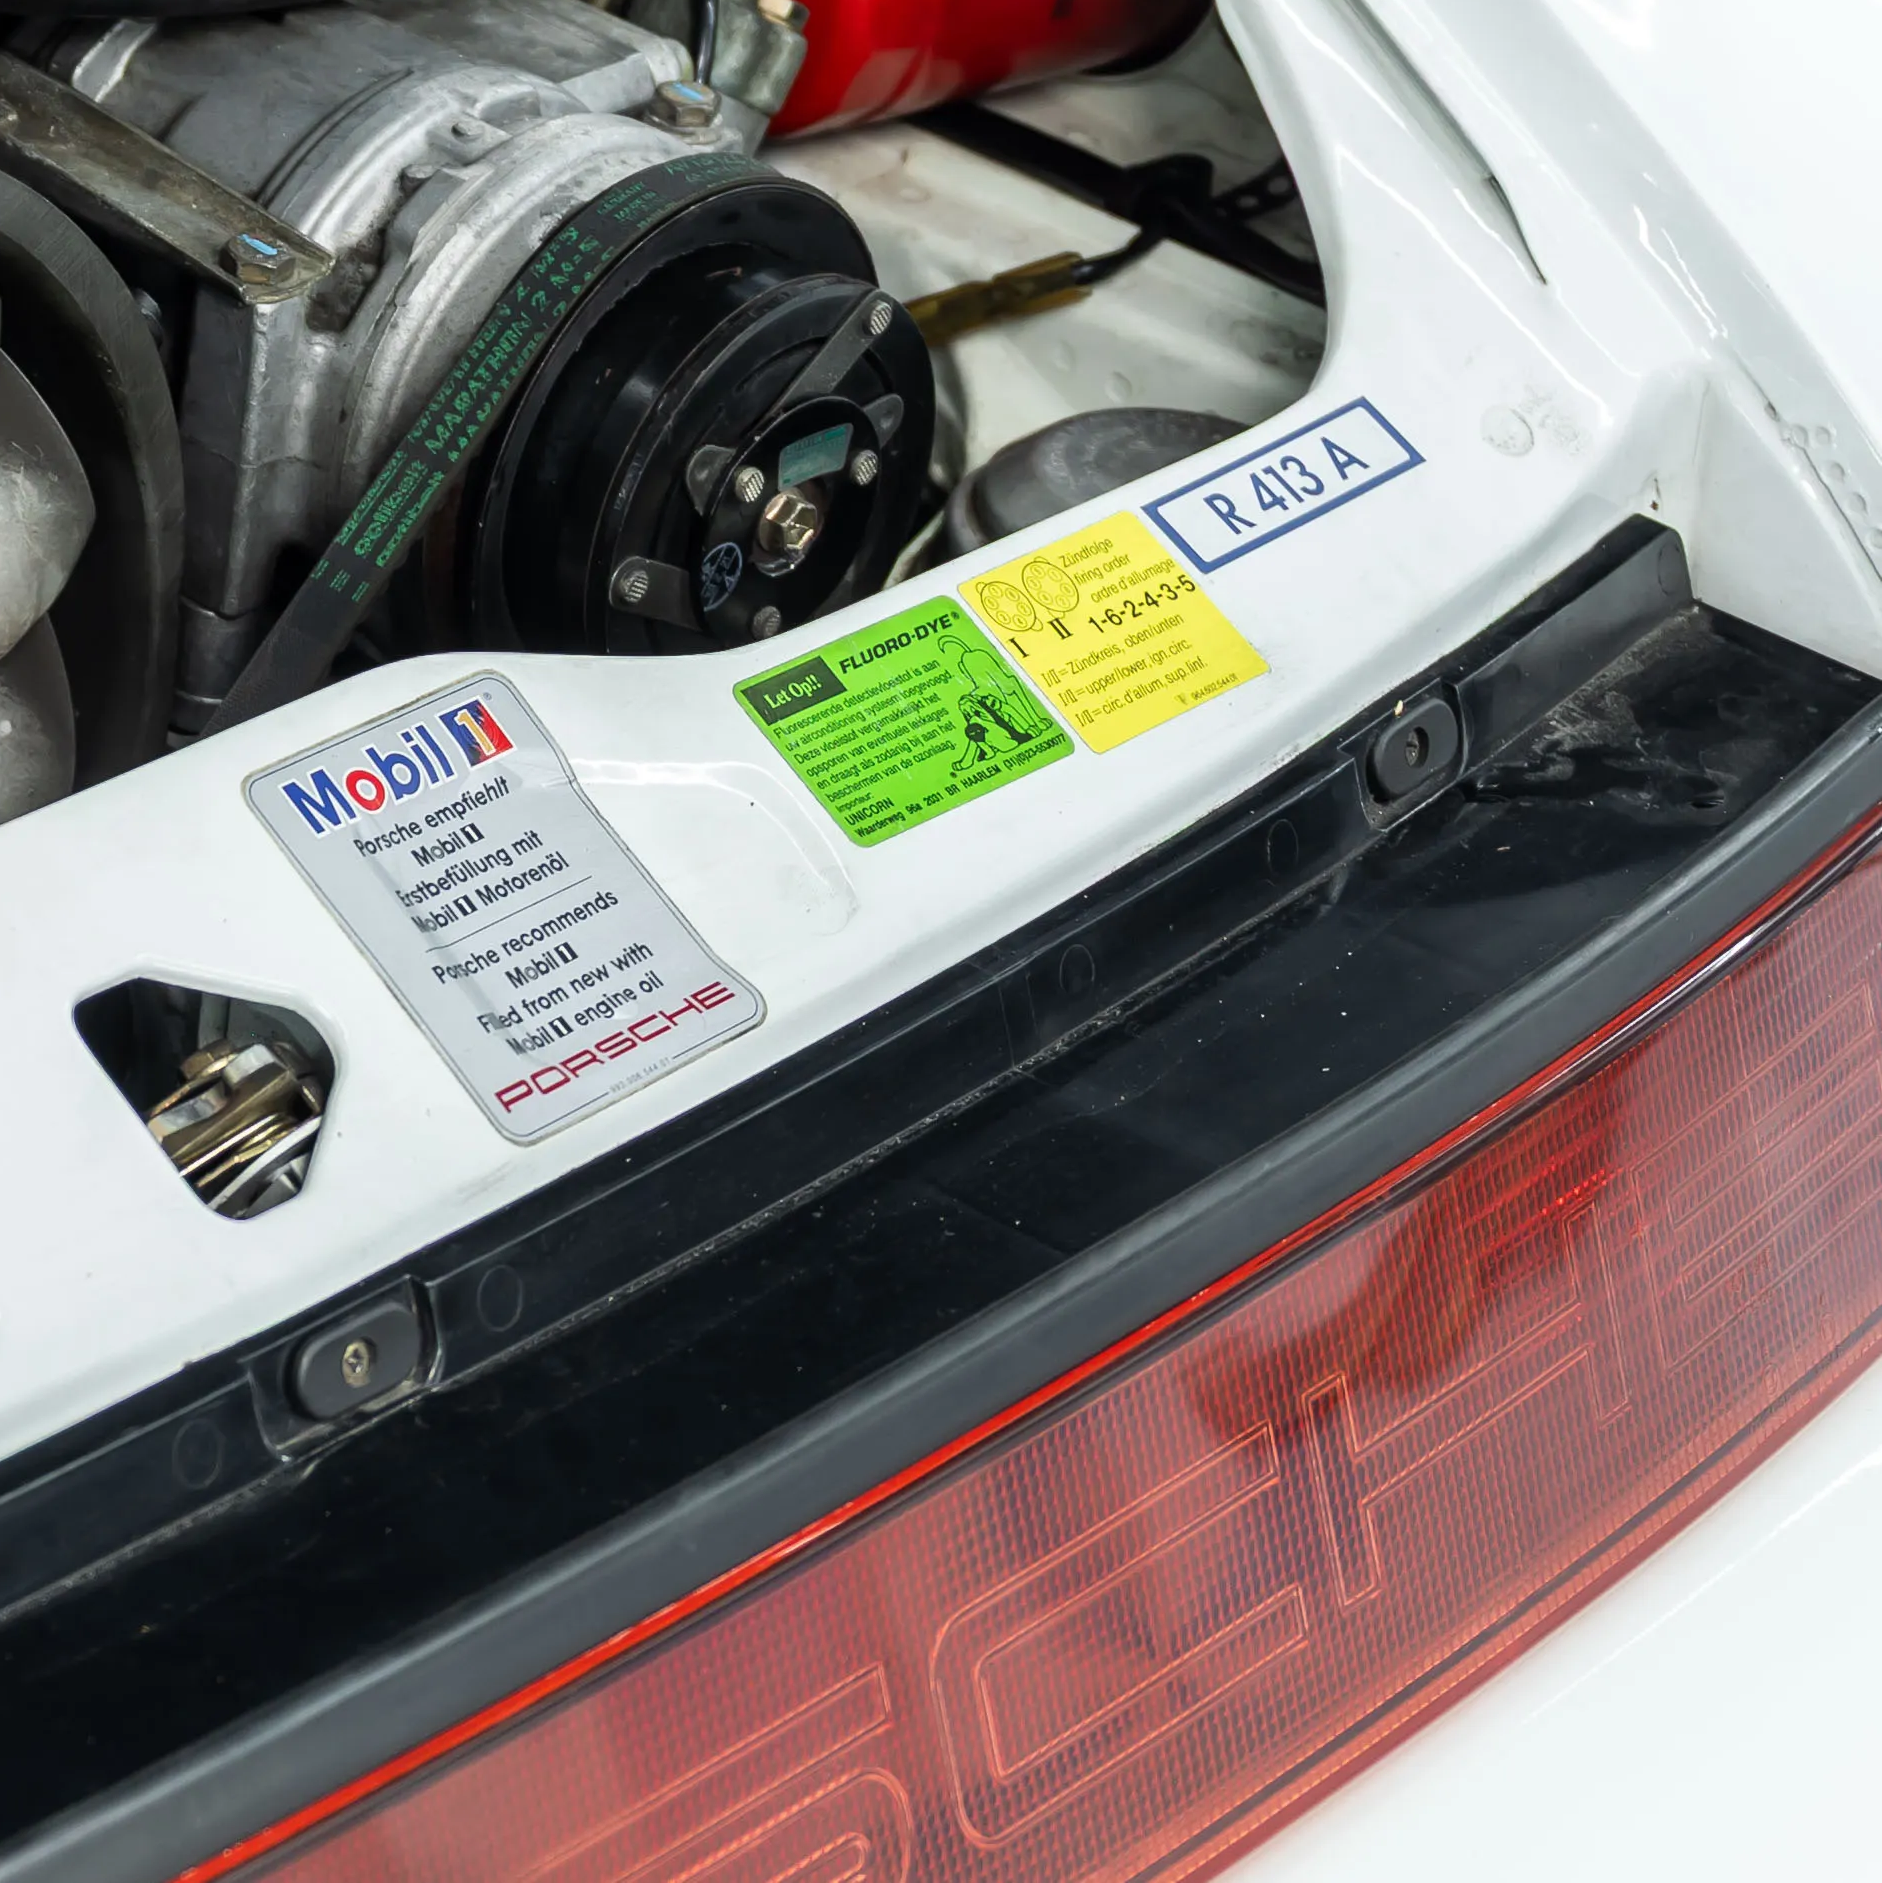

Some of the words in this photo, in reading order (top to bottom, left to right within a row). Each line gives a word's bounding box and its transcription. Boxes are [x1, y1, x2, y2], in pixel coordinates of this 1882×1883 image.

[1203, 493, 1256, 534] R
[1249, 455, 1324, 511] 413
[1320, 436, 1369, 480] A
[1058, 538, 1113, 568] Zündfolge
[1073, 567, 1103, 585] firing
[1102, 554, 1130, 572] order
[1090, 583, 1119, 603] ordre
[1118, 558, 1175, 590] d'allumage
[1088, 574, 1195, 633] 1-6-2-4-3-5
[1124, 614, 1184, 647] oben/unten
[1008, 637, 1029, 657] I
[1047, 617, 1073, 639] II
[763, 689, 791, 708] Let
[787, 674, 821, 697] Op!!
[1085, 658, 1152, 694] upper/lower,
[1168, 639, 1192, 655] circ.
[772, 703, 844, 739] Fluorescerende
[842, 669, 913, 707] detectievloeistof
[911, 668, 922, 676] is
[921, 659, 940, 672] aan
[785, 740, 800, 751] uw
[799, 711, 866, 745] airconditioning
[863, 694, 901, 716] systeem
[899, 669, 954, 699] toegevoegd.
[1102, 698, 1126, 714] circ.
[793, 748, 821, 764] Deze
[819, 728, 859, 752] vloeistof
[921, 692, 941, 705] het
[805, 752, 849, 777] opsporen
[847, 744, 867, 757] van
[866, 725, 910, 749] eventuele
[906, 707, 949, 730] lekkages
[816, 779, 830, 789] en
[829, 764, 861, 783] draagt
[859, 758, 875, 770] als
[873, 742, 912, 763] zodanig
[920, 728, 940, 742] aan
[936, 720, 956, 733] het
[275, 715, 466, 844] Mobil
[825, 772, 883, 802] beschermen
[881, 764, 901, 776] van
[899, 758, 913, 769] de
[854, 811, 906, 837] Waarderweg
[922, 791, 944, 806] 2031
[944, 783, 960, 795] BR
[960, 763, 1001, 788] HAARLEM
[352, 821, 422, 856] Porsche
[424, 775, 509, 827] empfiehlt
[844, 797, 894, 825] UNICORN
[394, 848, 513, 907] Erstbefüllung
[511, 830, 543, 855] mit
[410, 831, 466, 867] Mobil
[474, 850, 569, 906] Motorenöl
[431, 949, 500, 984] Porsche
[501, 891, 618, 956] recommends
[504, 950, 559, 988] Mobil
[521, 986, 569, 1016] from
[569, 964, 609, 993] new
[609, 942, 653, 971] with
[574, 988, 637, 1025] engine
[638, 970, 663, 992] oil
[494, 981, 735, 1112] PORSCHE
